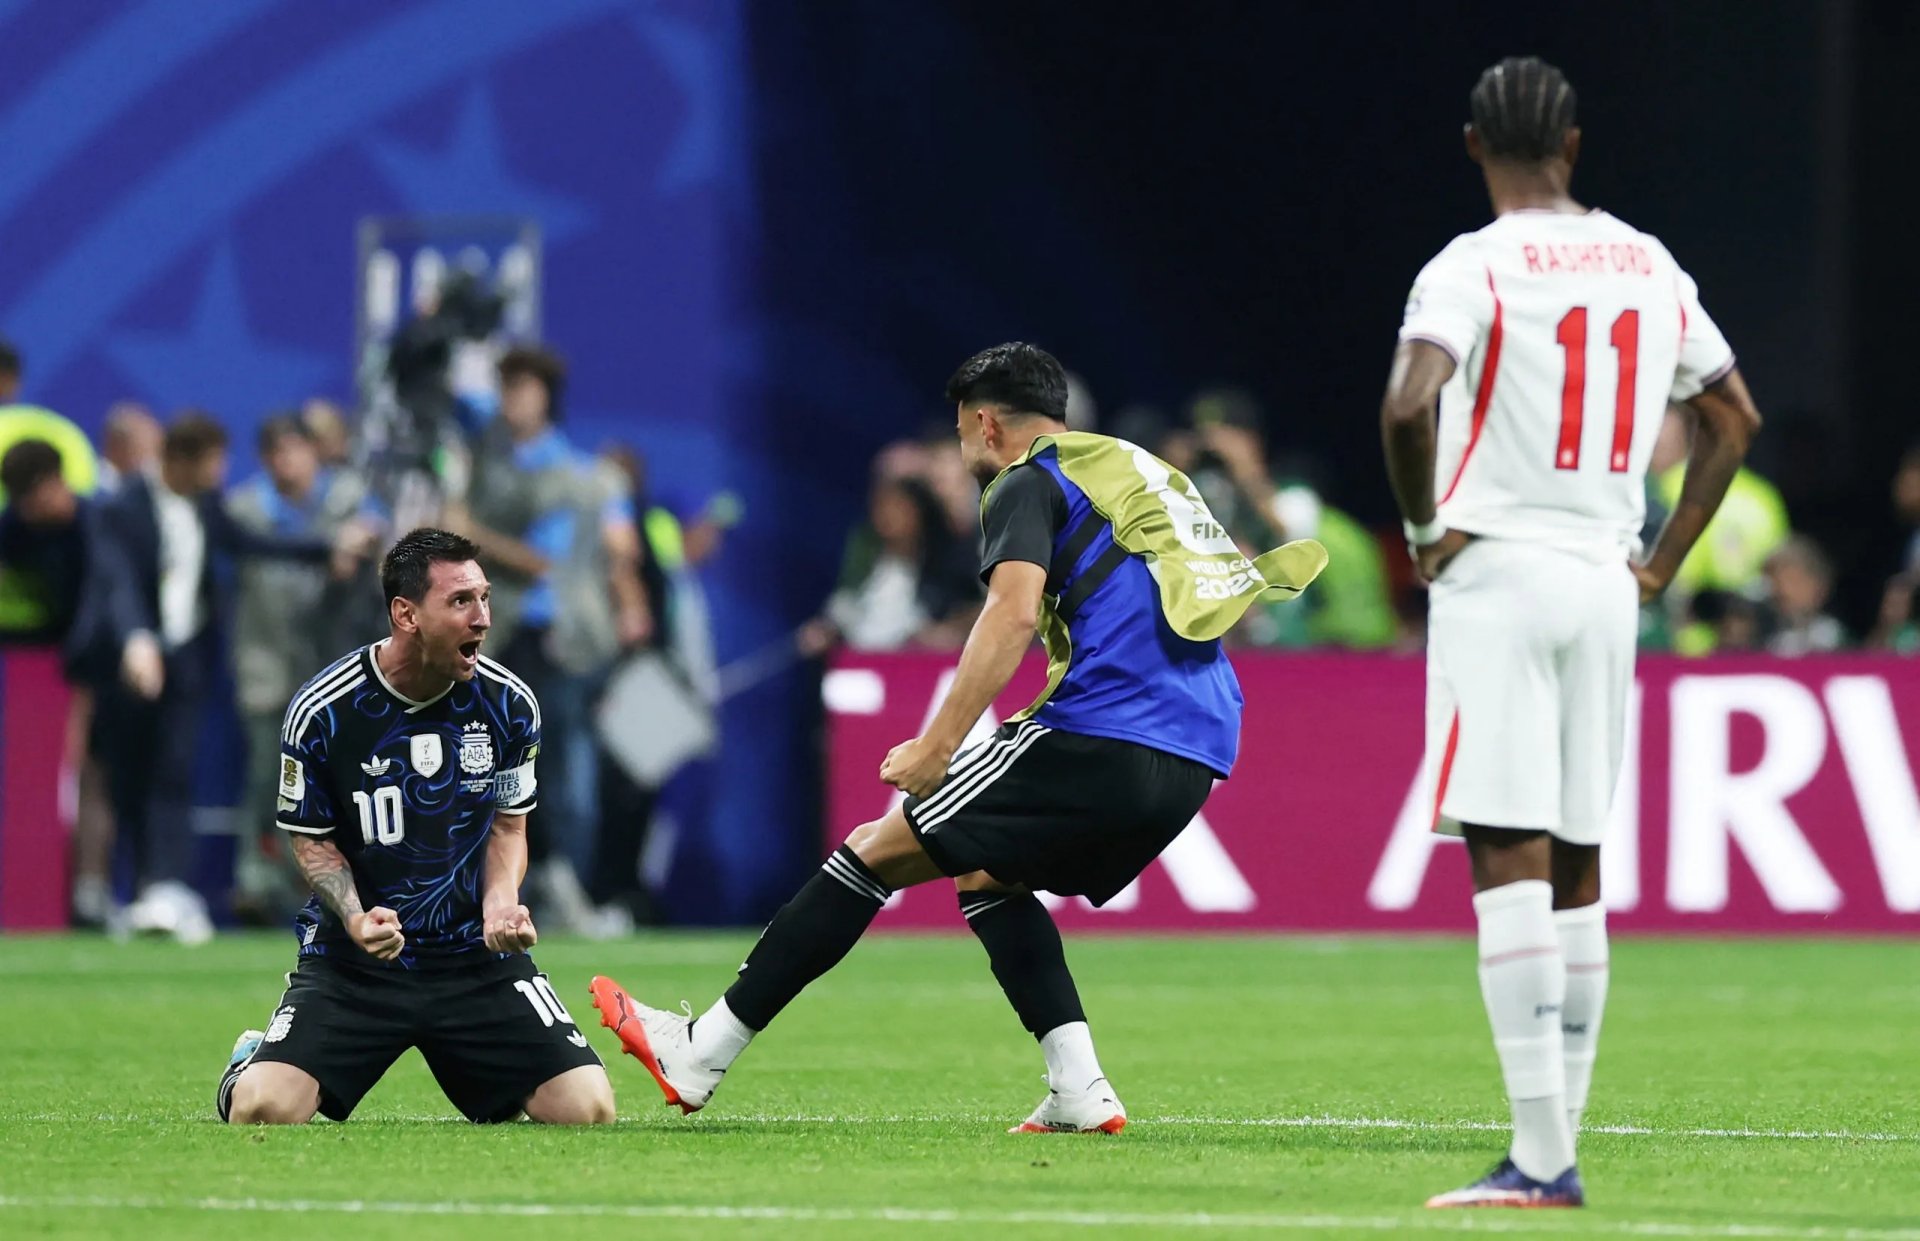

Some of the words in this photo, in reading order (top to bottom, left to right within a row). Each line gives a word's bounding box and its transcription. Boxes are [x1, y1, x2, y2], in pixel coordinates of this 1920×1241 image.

[1522, 244, 1653, 275] RASHFORD
[1555, 306, 1639, 473] 11
[1186, 561, 1228, 575] WORLD
[352, 785, 405, 846] 10
[513, 975, 575, 1028] 10
